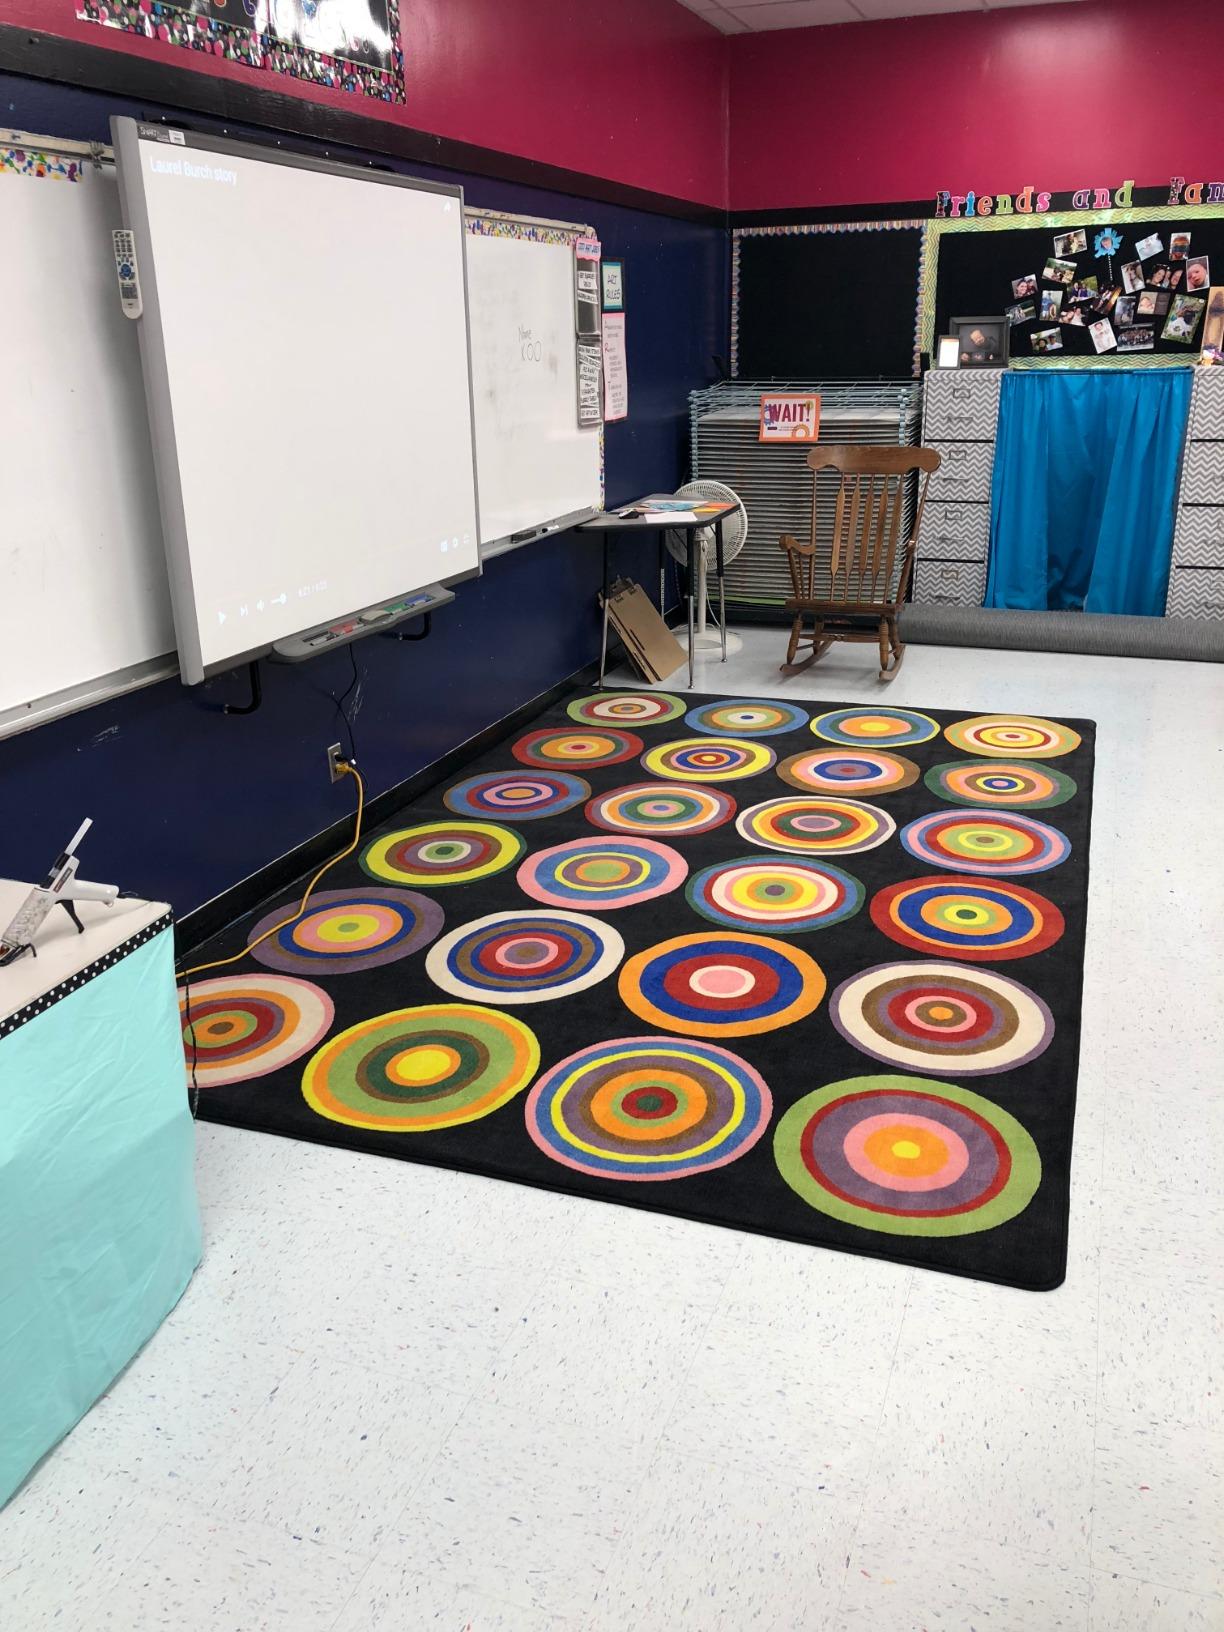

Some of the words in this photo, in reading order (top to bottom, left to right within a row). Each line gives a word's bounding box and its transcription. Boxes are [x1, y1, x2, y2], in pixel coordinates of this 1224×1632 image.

[150, 155, 181, 175] Laurel
[214, 166, 238, 187] story
[935, 186, 1051, 217] Friends
[1072, 180, 1135, 209] and
[768, 403, 810, 423] WAIT!
